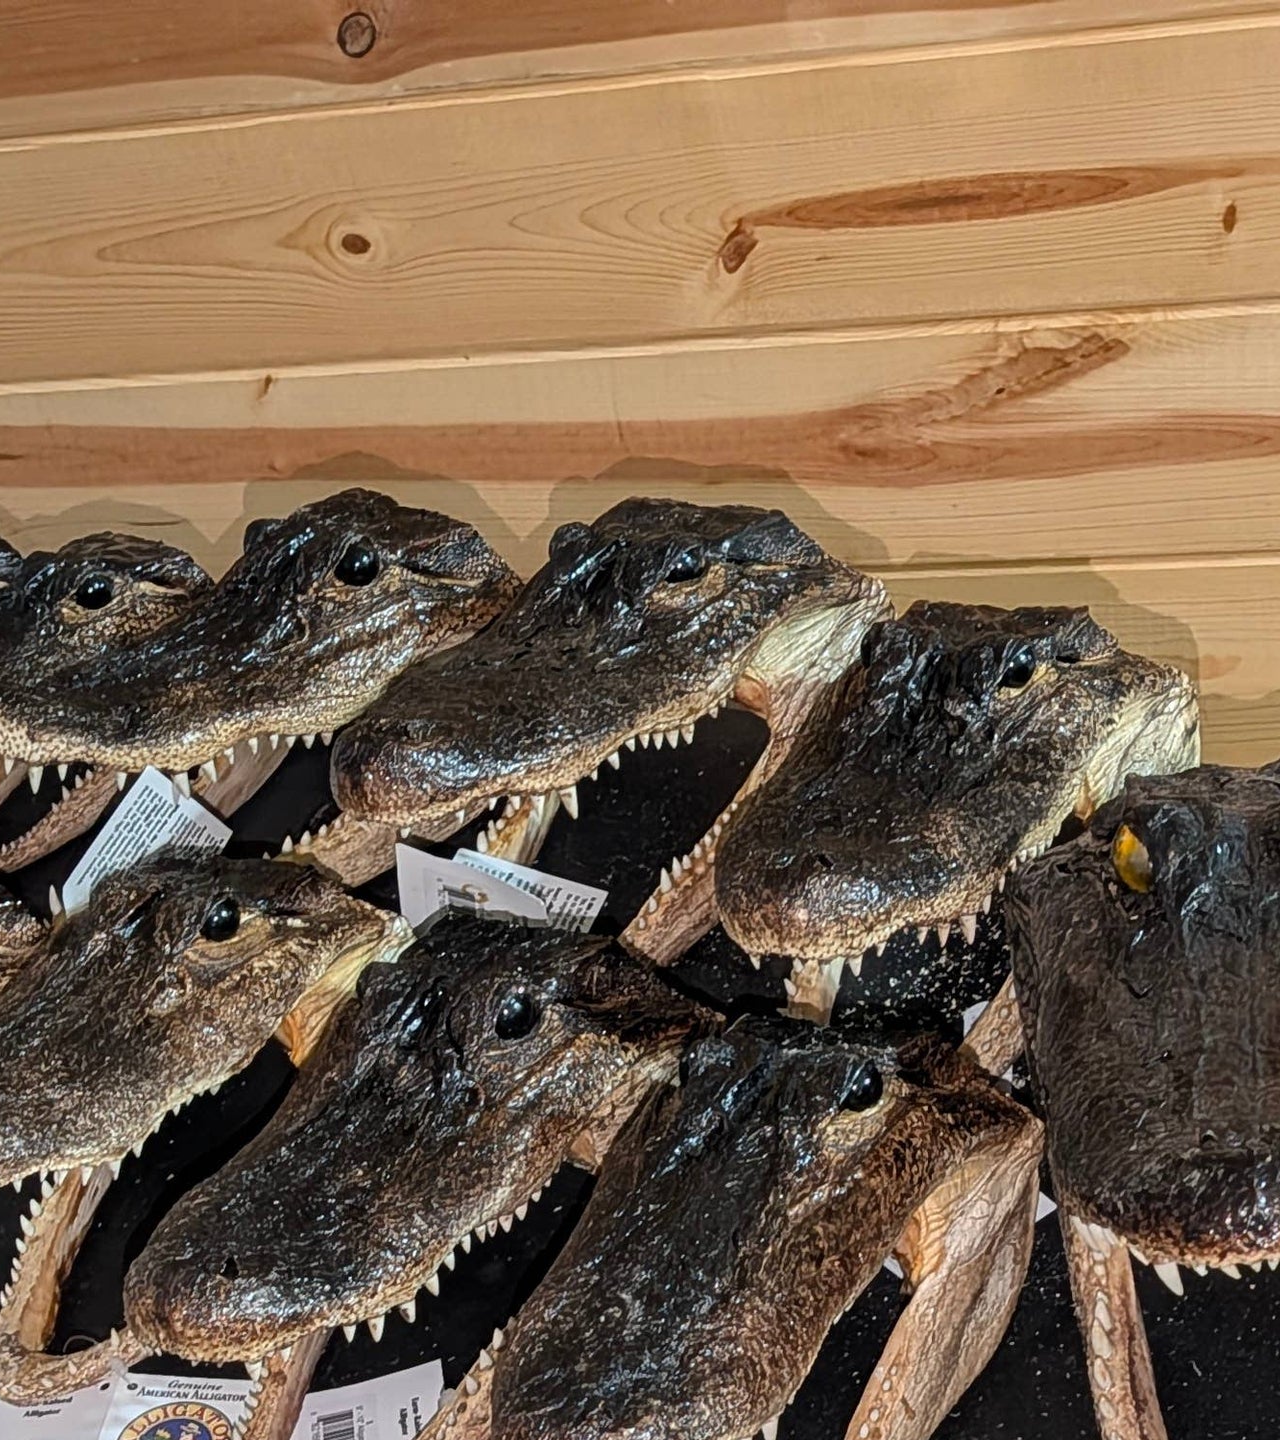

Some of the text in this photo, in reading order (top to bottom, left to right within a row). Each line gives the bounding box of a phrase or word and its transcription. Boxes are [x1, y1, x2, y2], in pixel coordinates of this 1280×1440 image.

[168, 1380, 223, 1390] Genuine
[136, 1387, 247, 1401] AMERICAN ALLIGATOR
